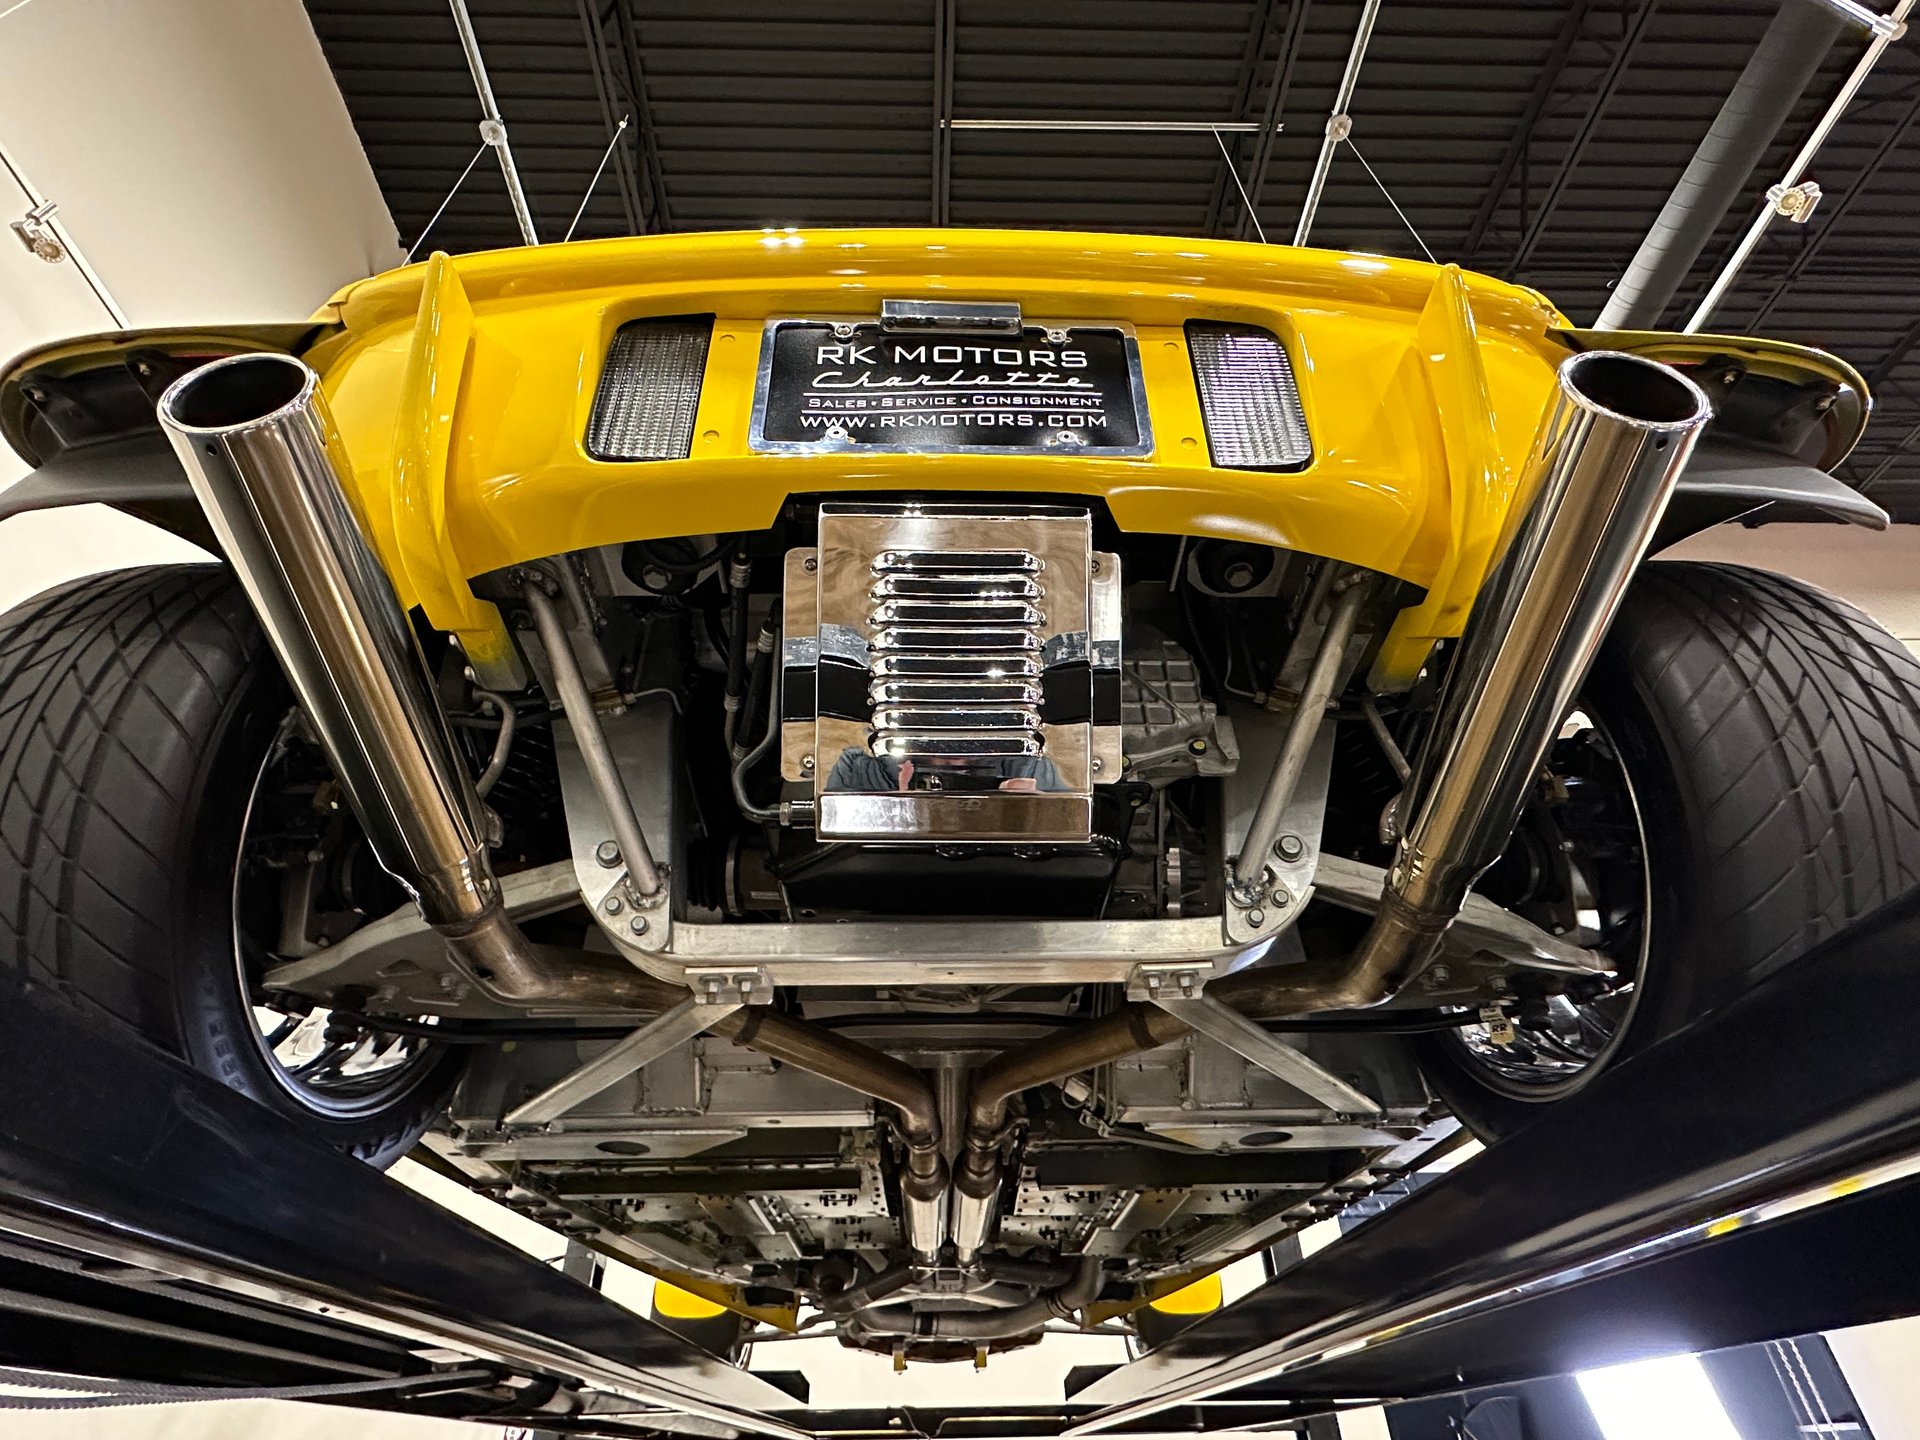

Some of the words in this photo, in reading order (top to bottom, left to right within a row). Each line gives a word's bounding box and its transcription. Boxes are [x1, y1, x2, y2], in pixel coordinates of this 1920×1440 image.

[816, 345, 877, 365] RK
[894, 345, 1088, 368] MOTORS
[811, 369, 1094, 388] Charlotte
[808, 398, 867, 408] SALES
[881, 396, 957, 407] SERVICE
[972, 395, 1103, 406] CONSIGNMENT
[800, 413, 1107, 428] WWW.RKMOTORS.COM
